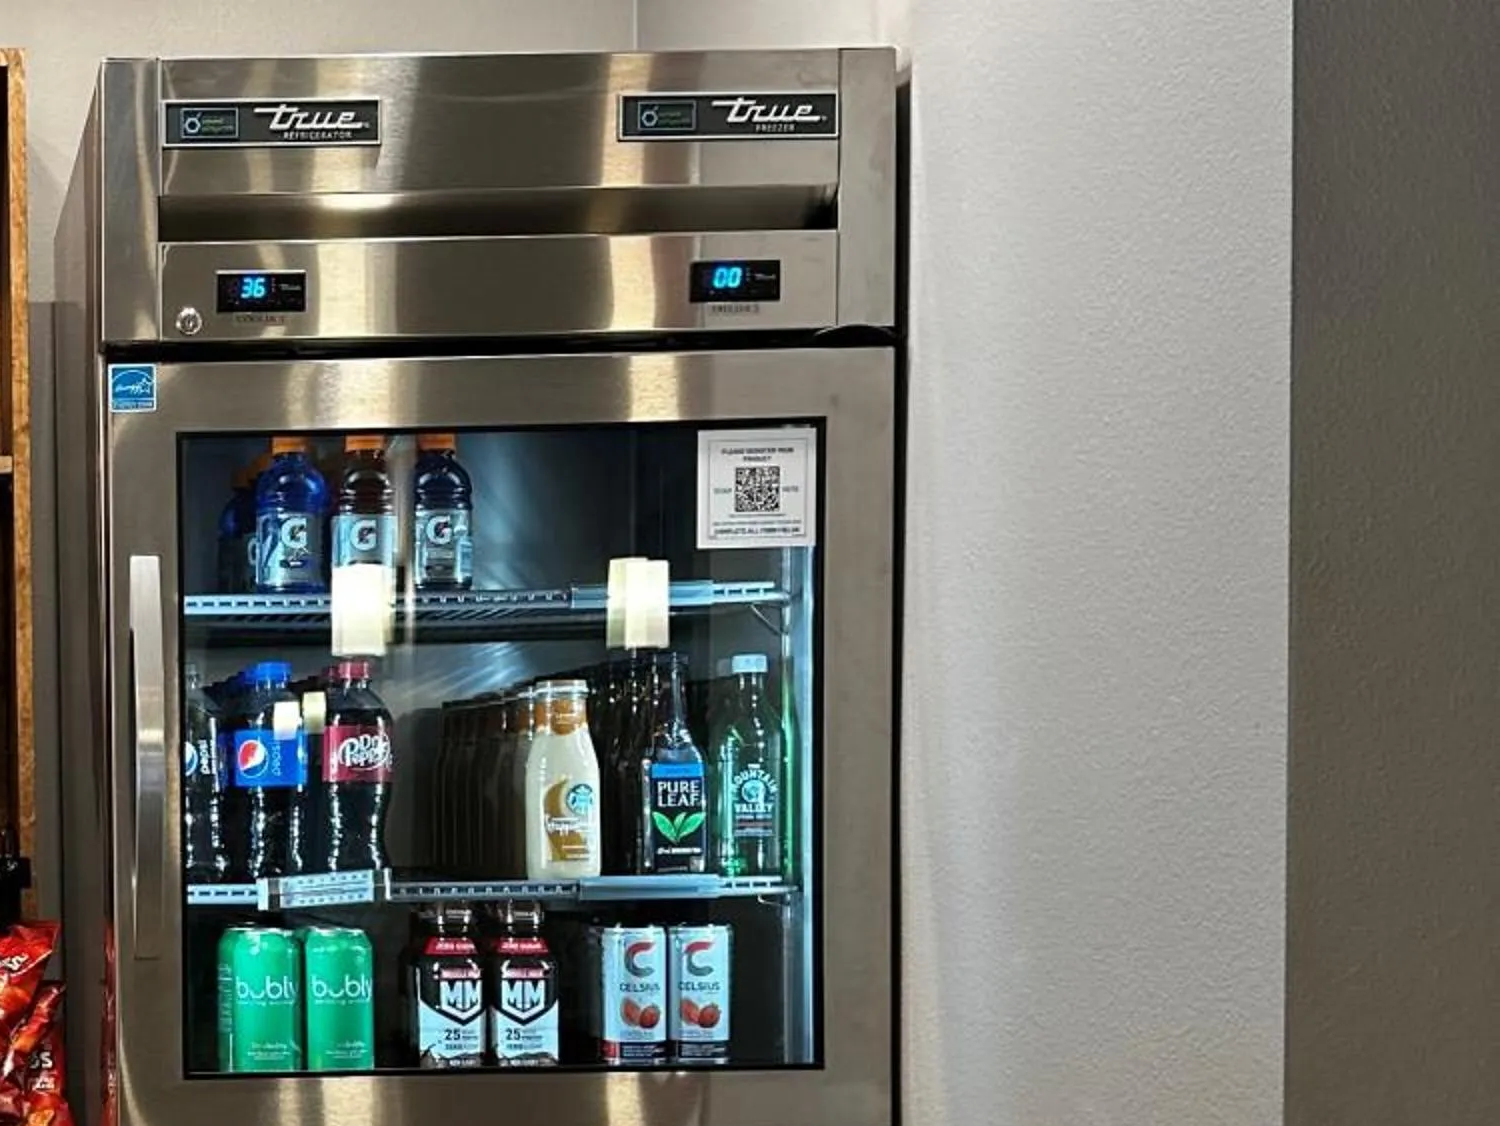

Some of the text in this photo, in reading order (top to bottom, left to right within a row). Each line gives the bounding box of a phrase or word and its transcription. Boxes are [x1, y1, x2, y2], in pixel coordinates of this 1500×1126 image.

[254, 104, 363, 130] true
[712, 97, 821, 123] true
[283, 131, 352, 140] REFRIGERATOR
[755, 124, 796, 132] FREEZER
[713, 267, 743, 288] 00
[241, 278, 265, 298] 36
[281, 517, 307, 548] G
[351, 519, 377, 550] G
[426, 516, 452, 545] G
[657, 780, 700, 793] PURE
[657, 793, 700, 807] LEAF
[311, 973, 373, 1001] bubly
[678, 981, 721, 991] CELSIUS
[445, 1028, 461, 1041] 25
[506, 1028, 521, 1041] 25
